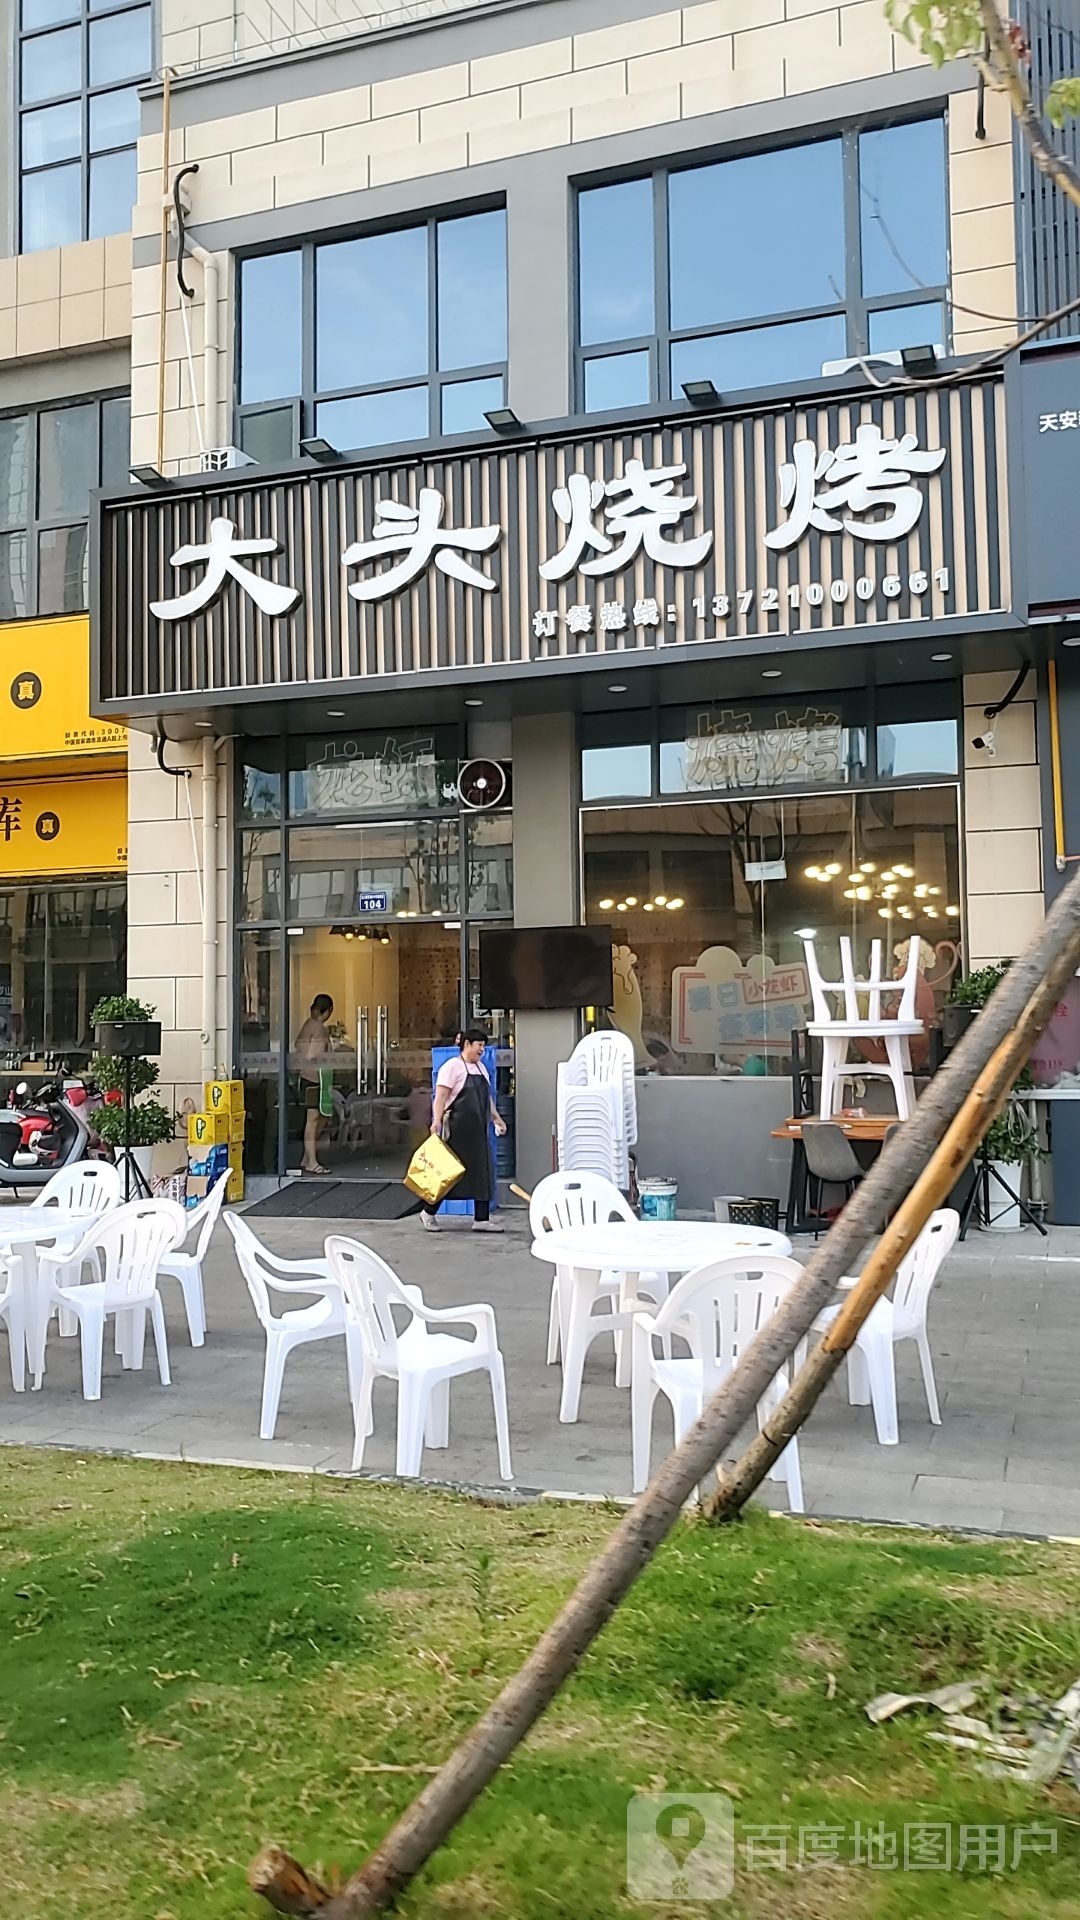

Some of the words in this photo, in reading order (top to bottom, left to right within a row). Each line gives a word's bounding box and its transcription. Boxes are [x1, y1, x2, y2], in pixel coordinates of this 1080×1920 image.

[1039, 410, 1080, 433] 天安
[149, 424, 947, 620] 大头烧烤
[363, 899, 382, 909] 104
[748, 974, 799, 998] 小龙虾
